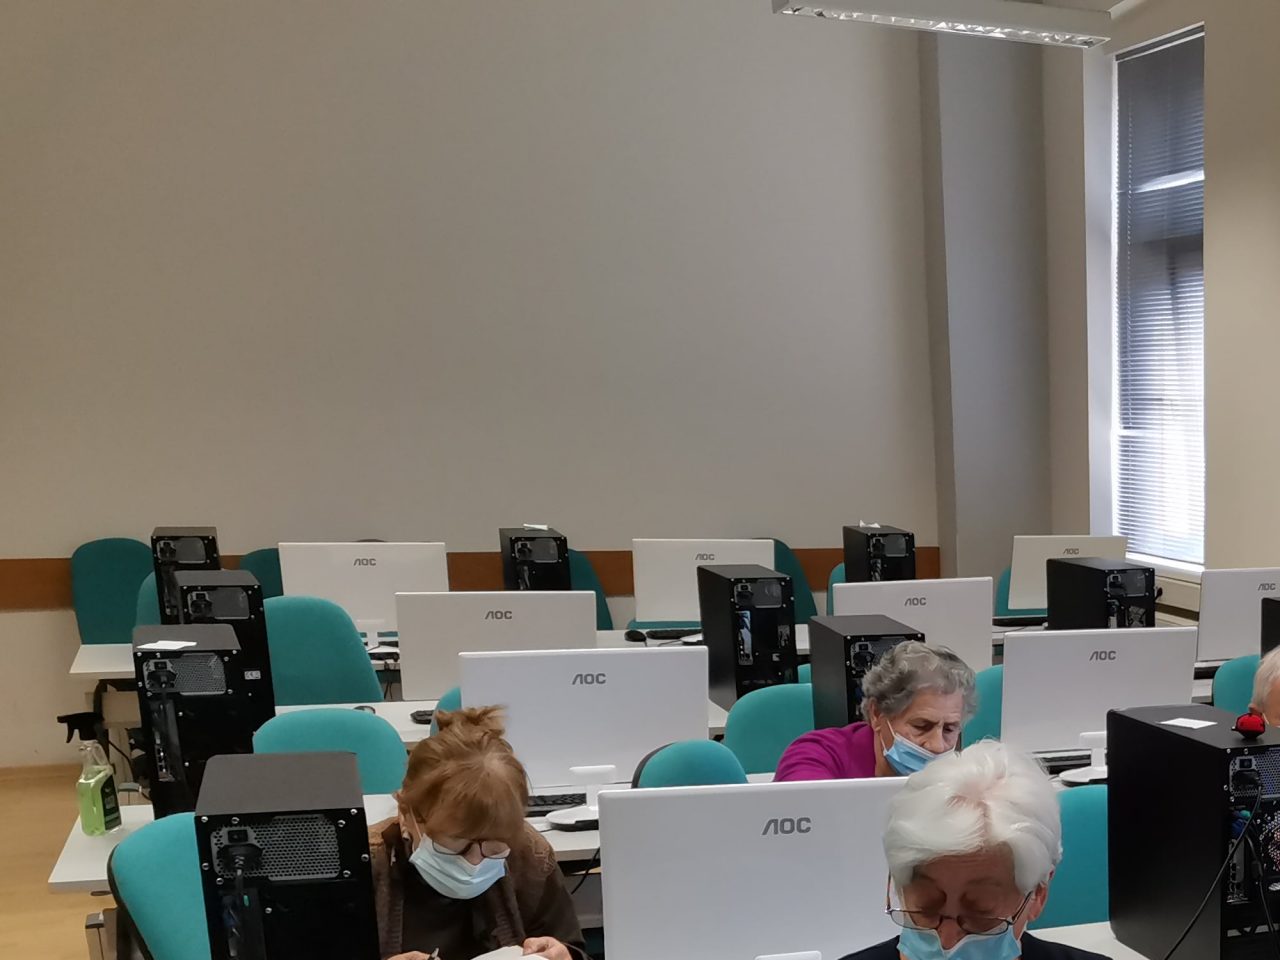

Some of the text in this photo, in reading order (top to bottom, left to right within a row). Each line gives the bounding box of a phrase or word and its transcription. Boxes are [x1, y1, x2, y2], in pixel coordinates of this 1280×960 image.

[354, 558, 376, 566] AOC
[1258, 583, 1275, 591] AOC
[904, 597, 927, 606] AOC
[485, 610, 512, 620] AOC
[1089, 651, 1116, 661] AOC
[572, 673, 606, 686] AOC
[762, 816, 811, 836] AOC
